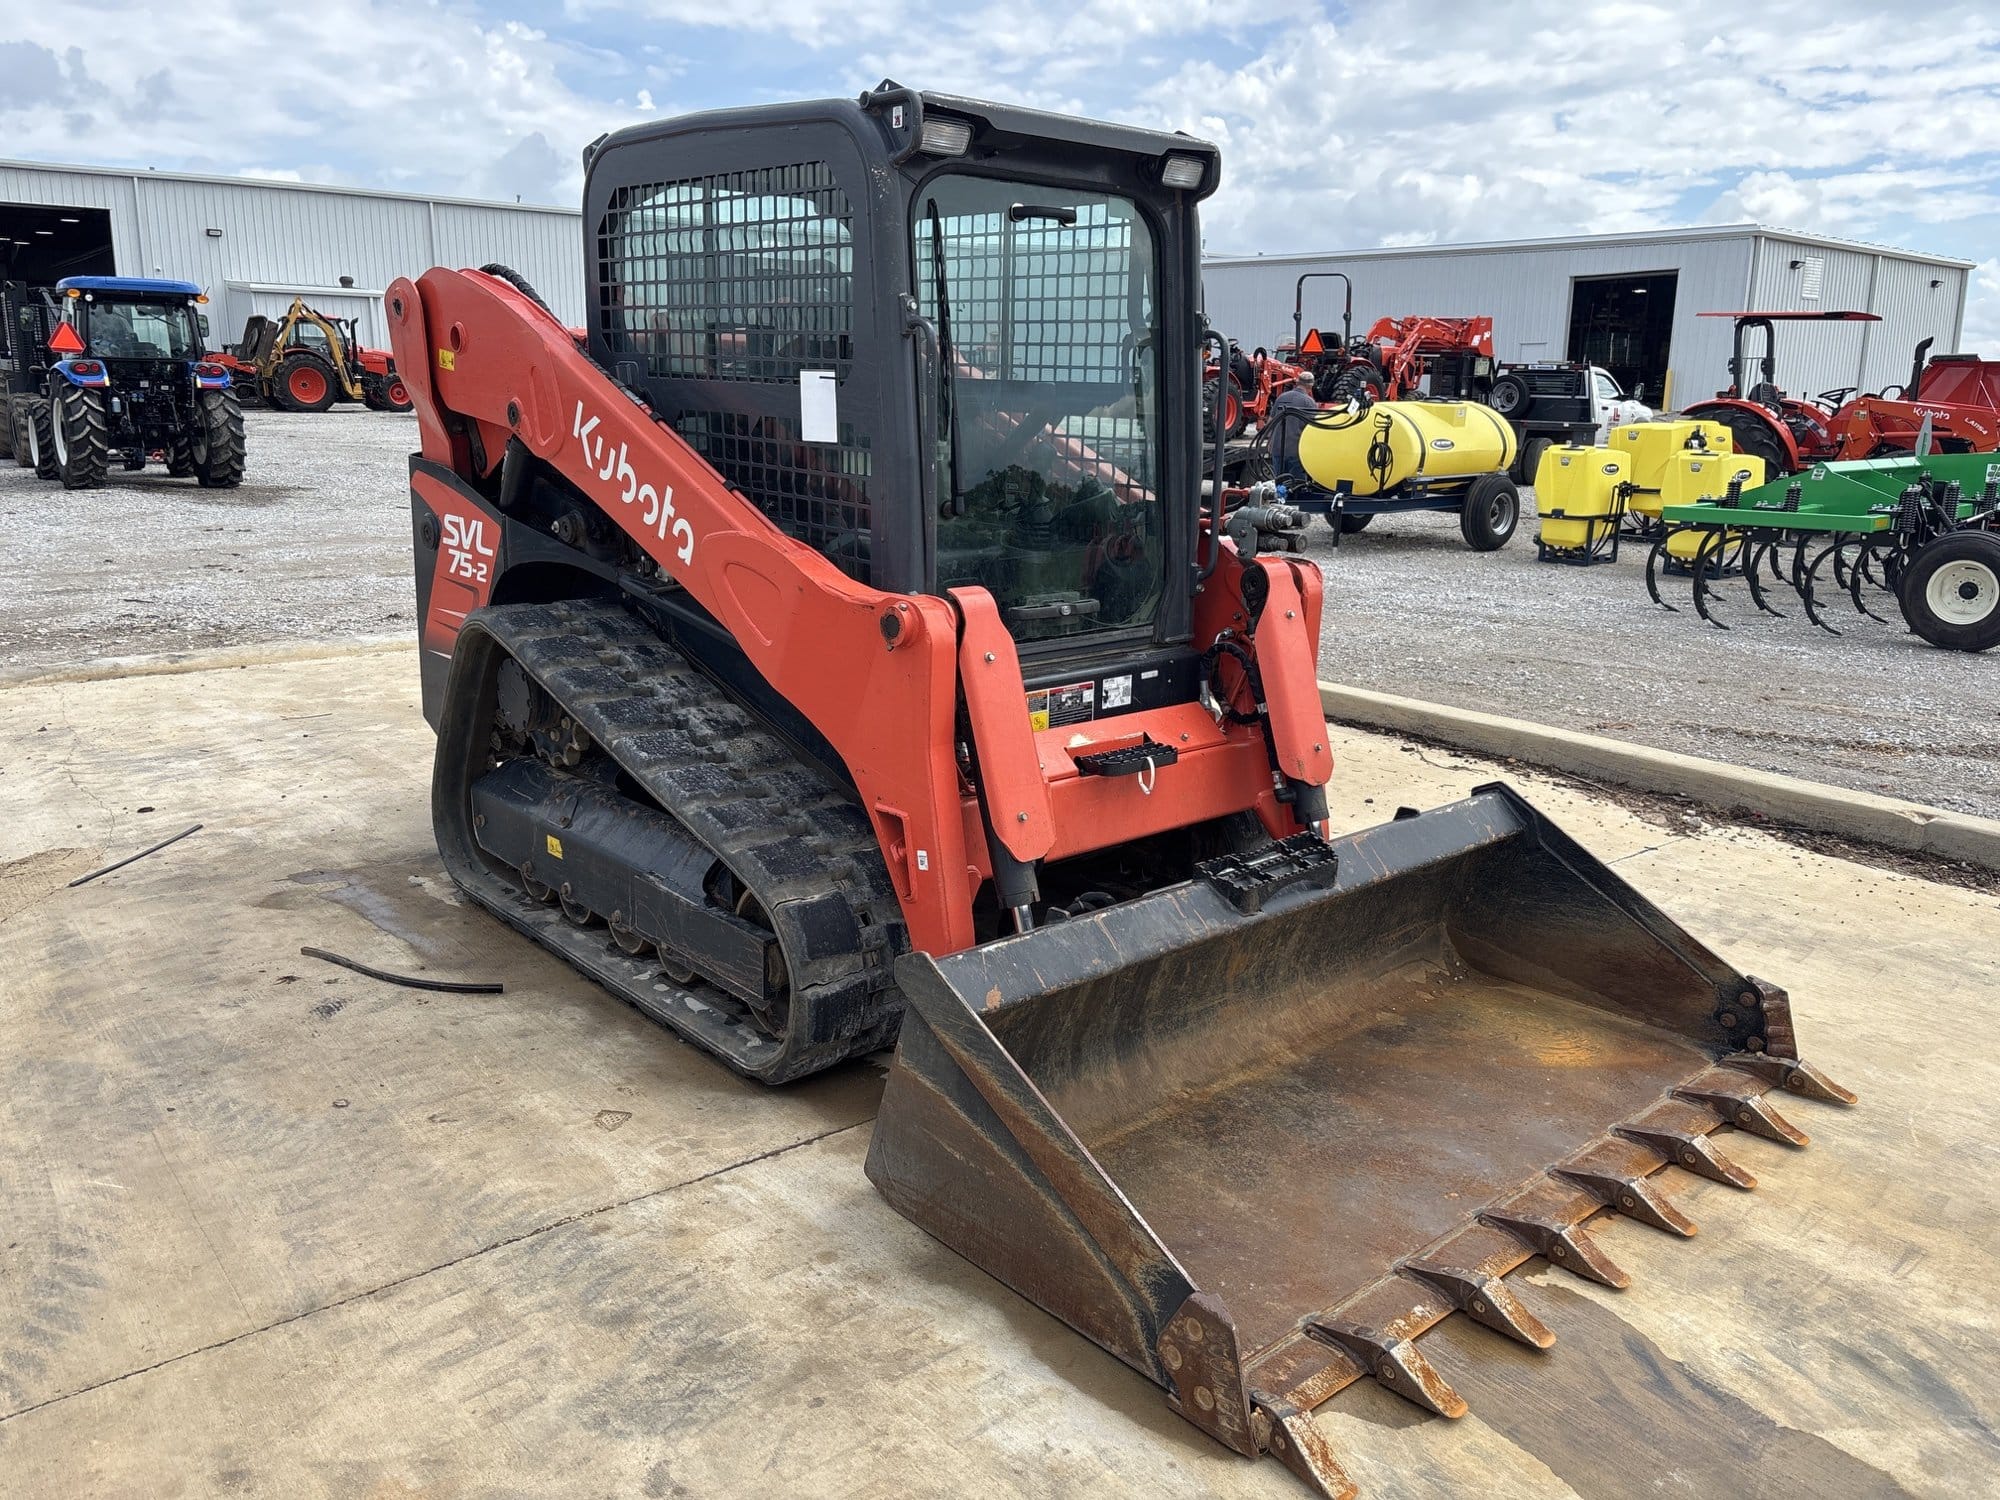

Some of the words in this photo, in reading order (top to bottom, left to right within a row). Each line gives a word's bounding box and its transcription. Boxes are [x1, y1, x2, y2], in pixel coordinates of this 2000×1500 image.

[573, 400, 694, 567] Kubota
[442, 513, 494, 557] SVL
[448, 548, 488, 583] 75-2
